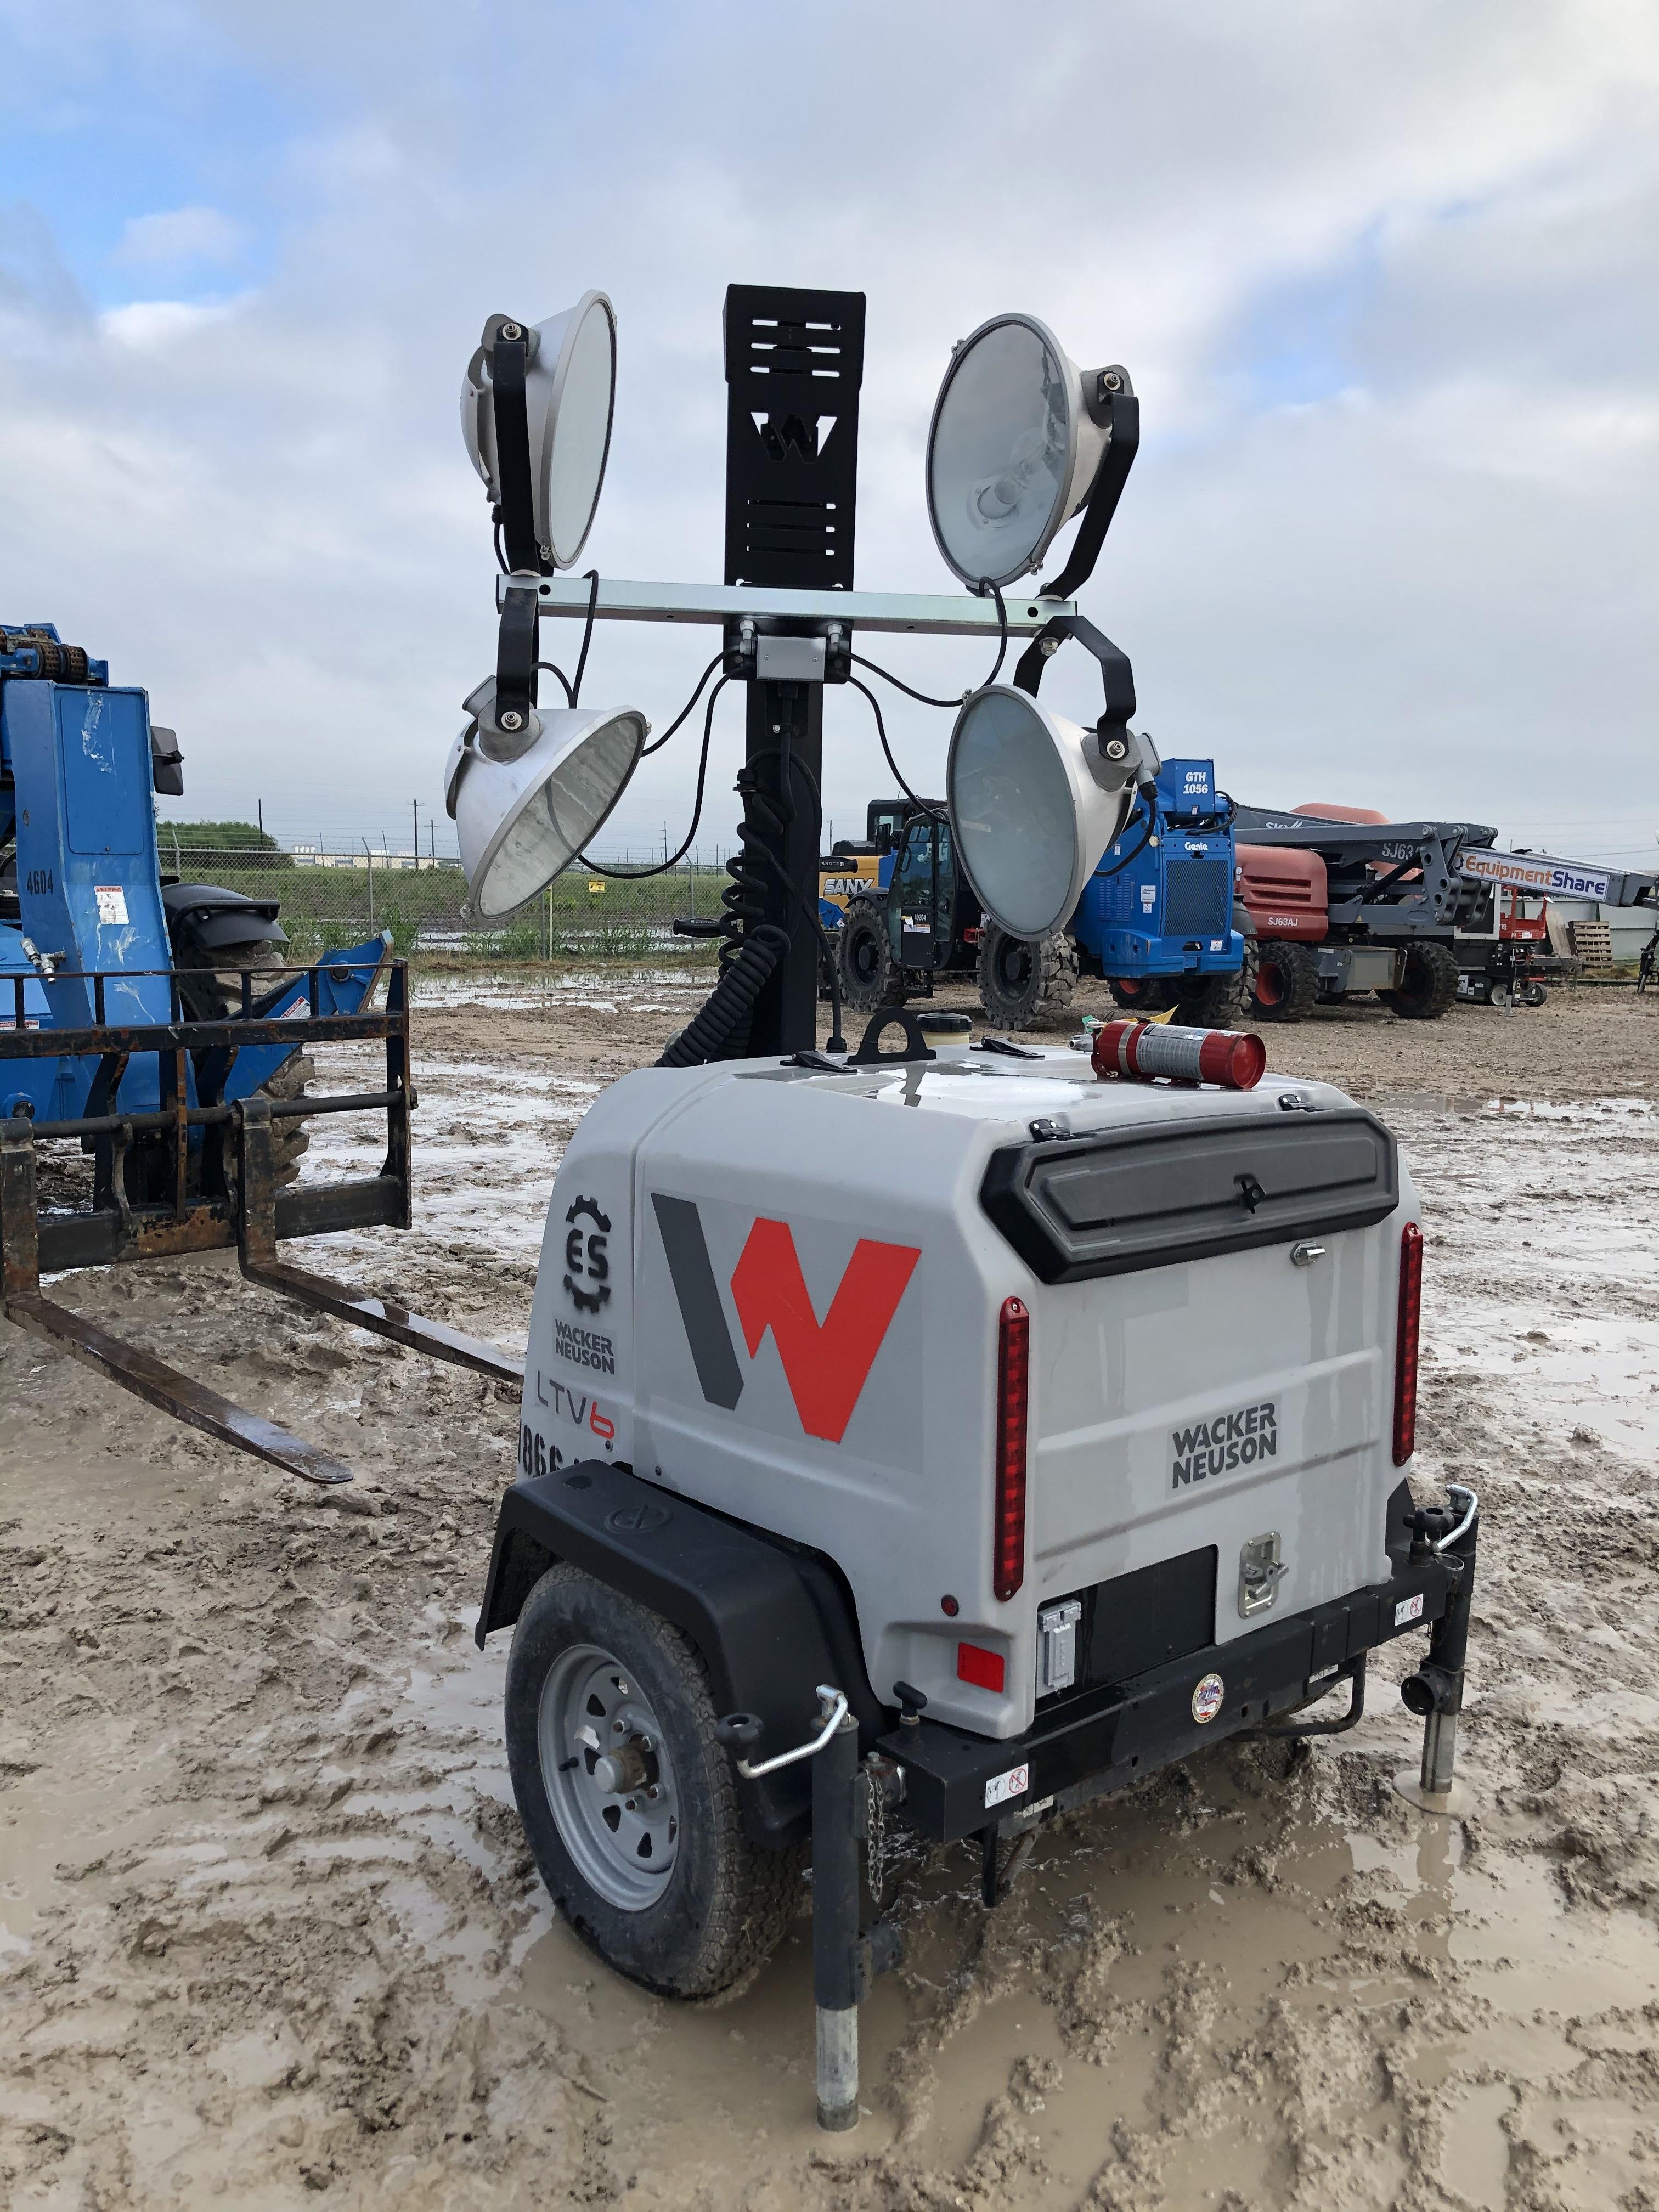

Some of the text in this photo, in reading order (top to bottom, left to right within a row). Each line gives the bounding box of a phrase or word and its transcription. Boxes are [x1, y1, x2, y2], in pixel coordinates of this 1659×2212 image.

[1183, 783, 1208, 794] 1056
[1186, 771, 1206, 782] GTH
[1184, 841, 1209, 851] Genie
[26, 868, 54, 896] 4604
[825, 878, 874, 895] SANY
[1465, 856, 1605, 895] EquipmentShare
[1268, 917, 1299, 927] SJ63AJ
[566, 1228, 608, 1279] ES
[555, 1318, 613, 1356] WACKER
[556, 1338, 614, 1375] NEUSON
[537, 1370, 615, 1440] LTV6
[1172, 1403, 1277, 1458] WACKER
[1172, 1429, 1276, 1489] NEUSON
